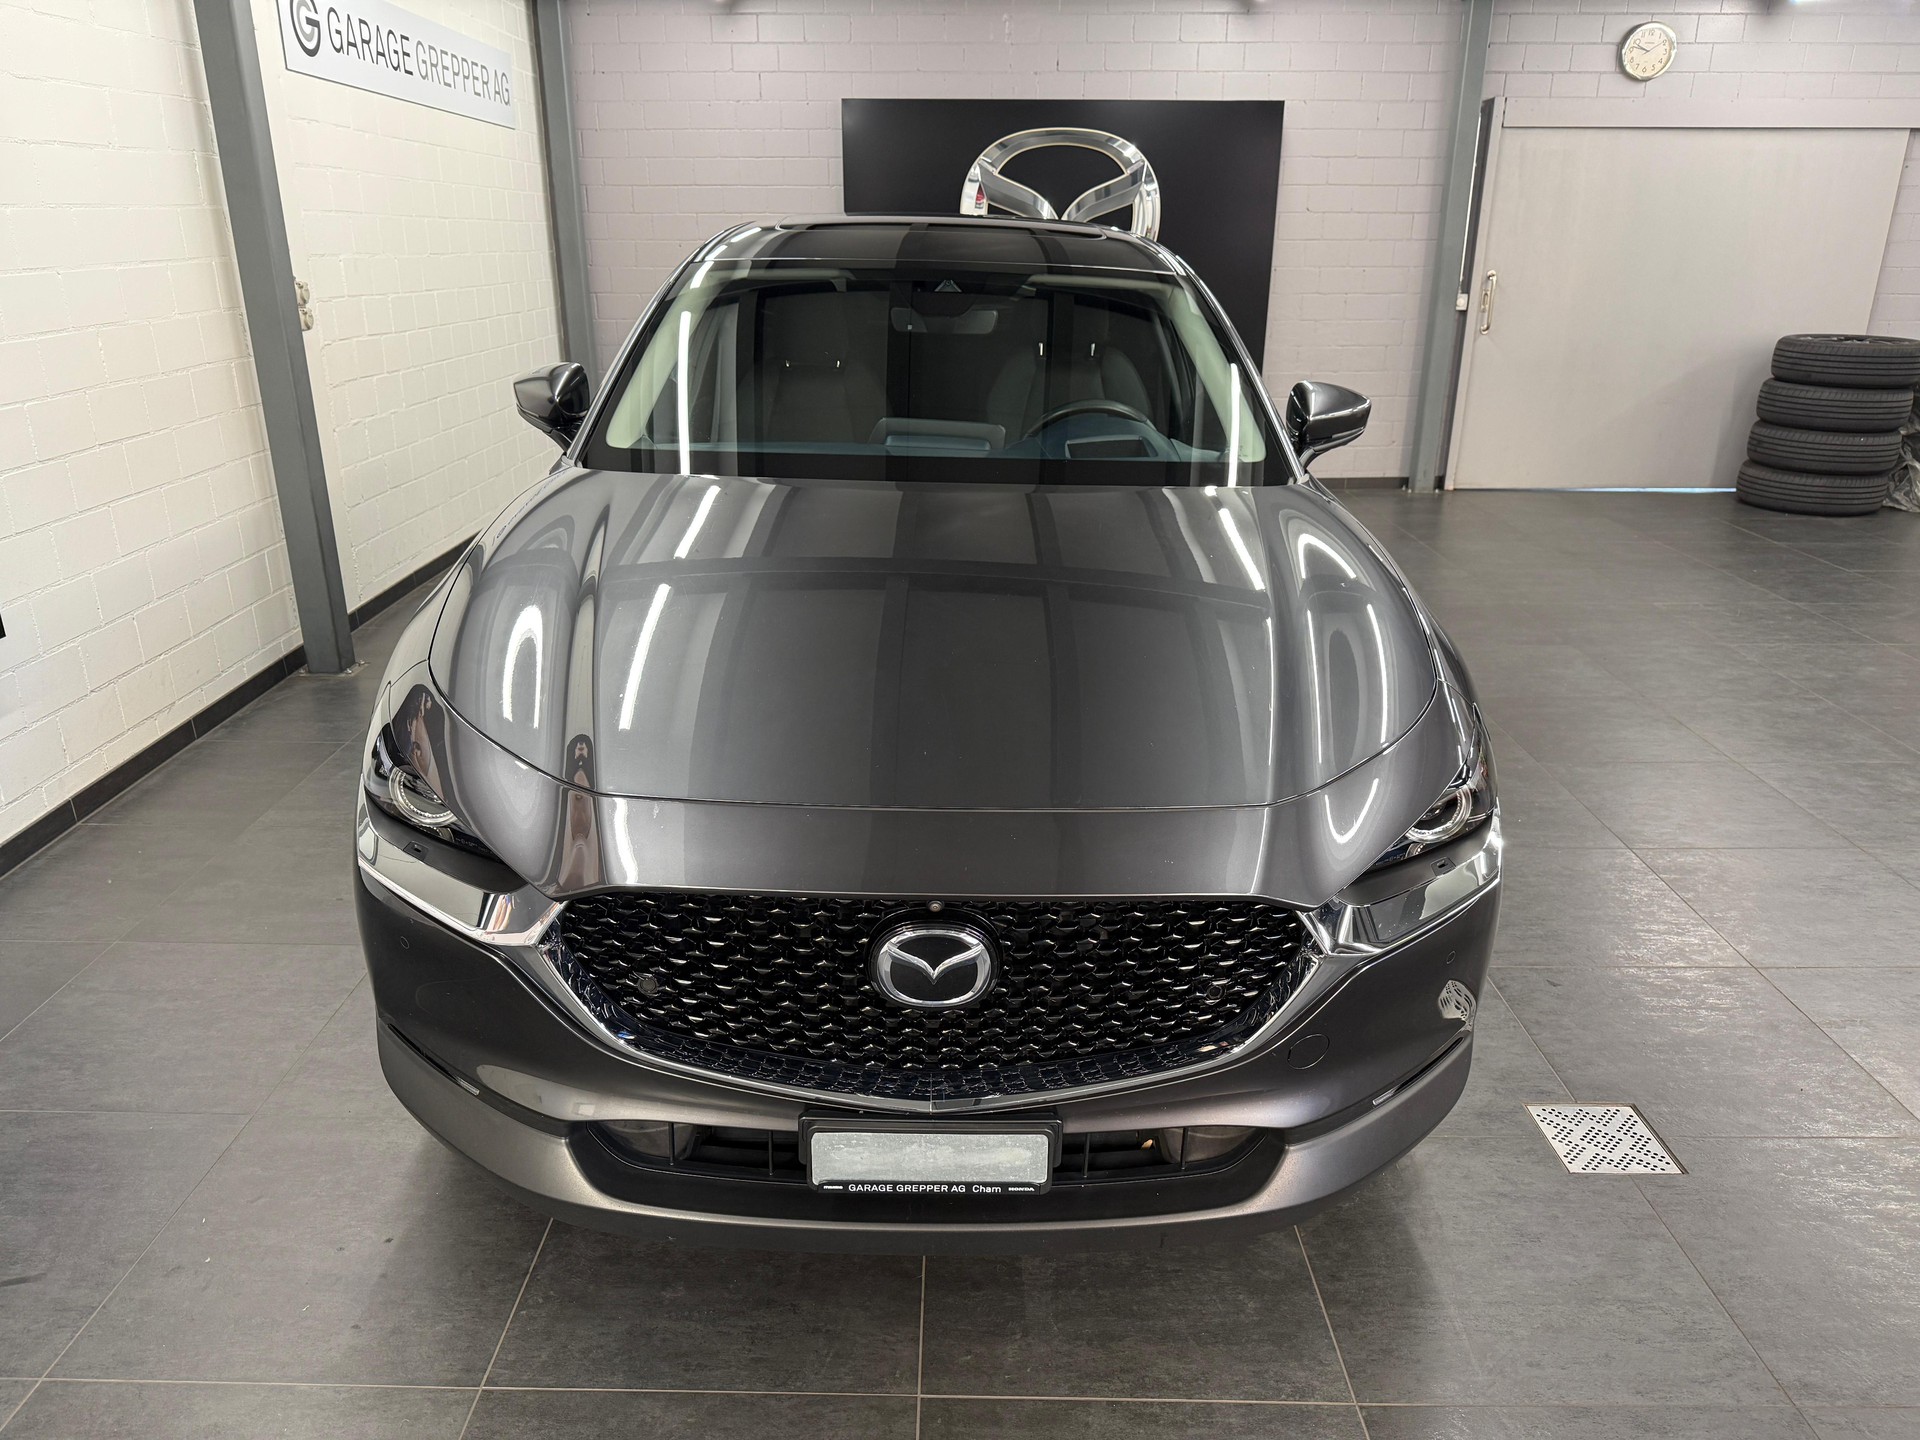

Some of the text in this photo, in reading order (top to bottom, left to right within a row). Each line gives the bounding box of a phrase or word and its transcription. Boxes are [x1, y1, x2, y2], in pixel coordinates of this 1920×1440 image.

[327, 7, 511, 106] GARAGE GREPPER AG
[848, 1183, 894, 1192] GARAGE
[896, 1184, 949, 1192] GREPPER
[950, 1184, 966, 1193] AG
[972, 1184, 1002, 1193] Cham
